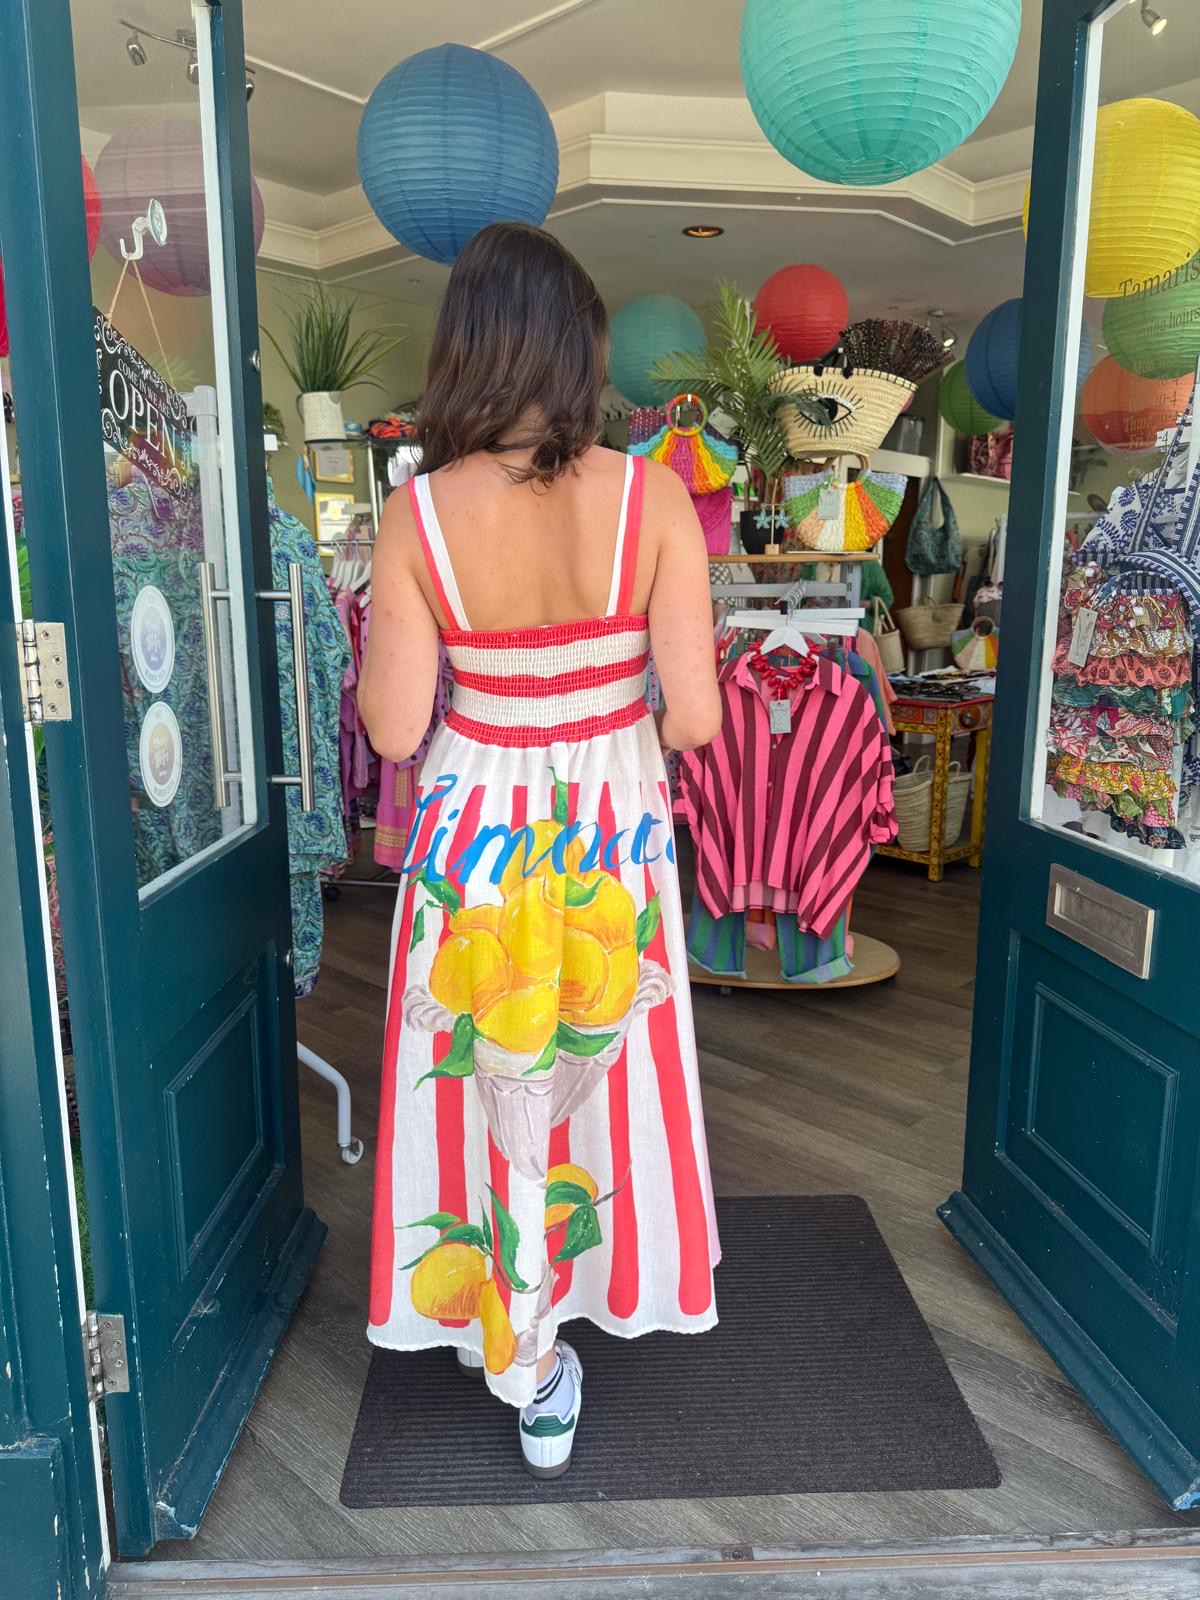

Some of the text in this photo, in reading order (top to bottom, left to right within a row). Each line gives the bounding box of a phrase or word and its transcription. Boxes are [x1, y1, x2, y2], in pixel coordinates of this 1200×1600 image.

[1168, 307, 1200, 329] hours
[109, 369, 177, 467] OPEN
[118, 358, 171, 420] COME IN WE ARE
